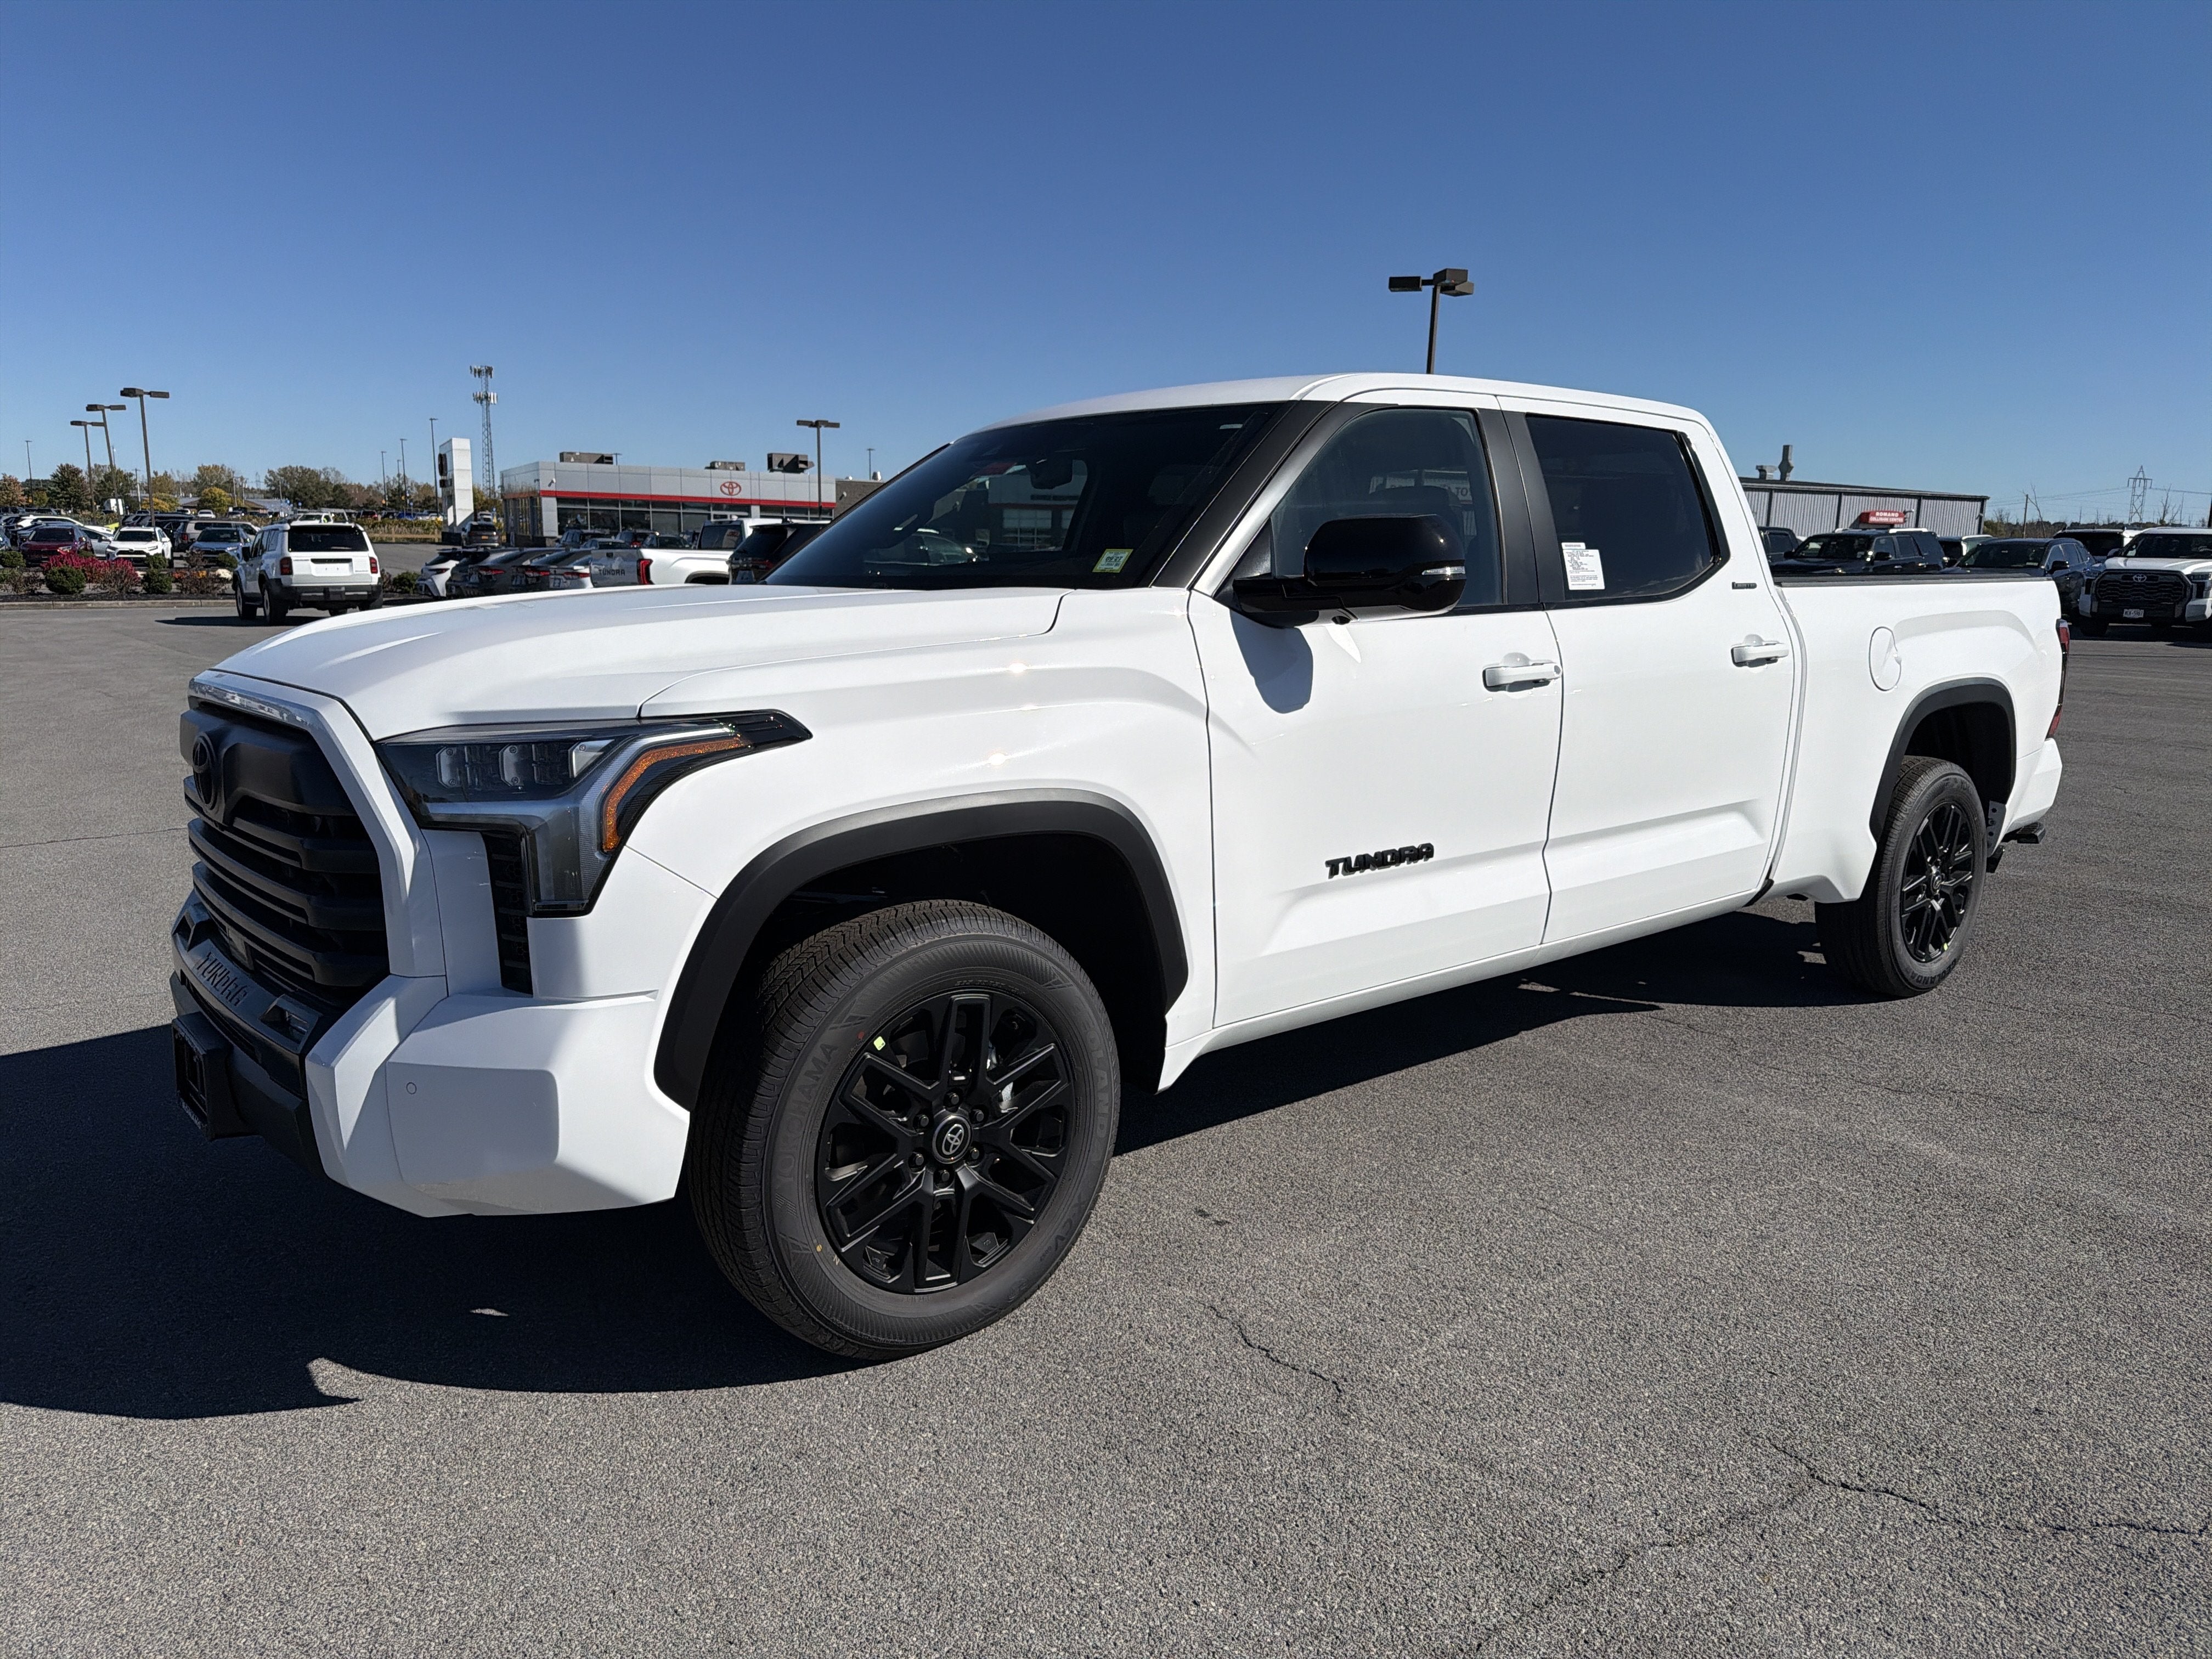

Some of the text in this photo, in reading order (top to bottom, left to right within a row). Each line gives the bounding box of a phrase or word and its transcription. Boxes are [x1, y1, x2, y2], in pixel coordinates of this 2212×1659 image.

[1325, 843, 1435, 879] TUNDRA
[197, 952, 248, 1007] TUNDRA
[775, 1043, 839, 1189] YOKOHAMA
